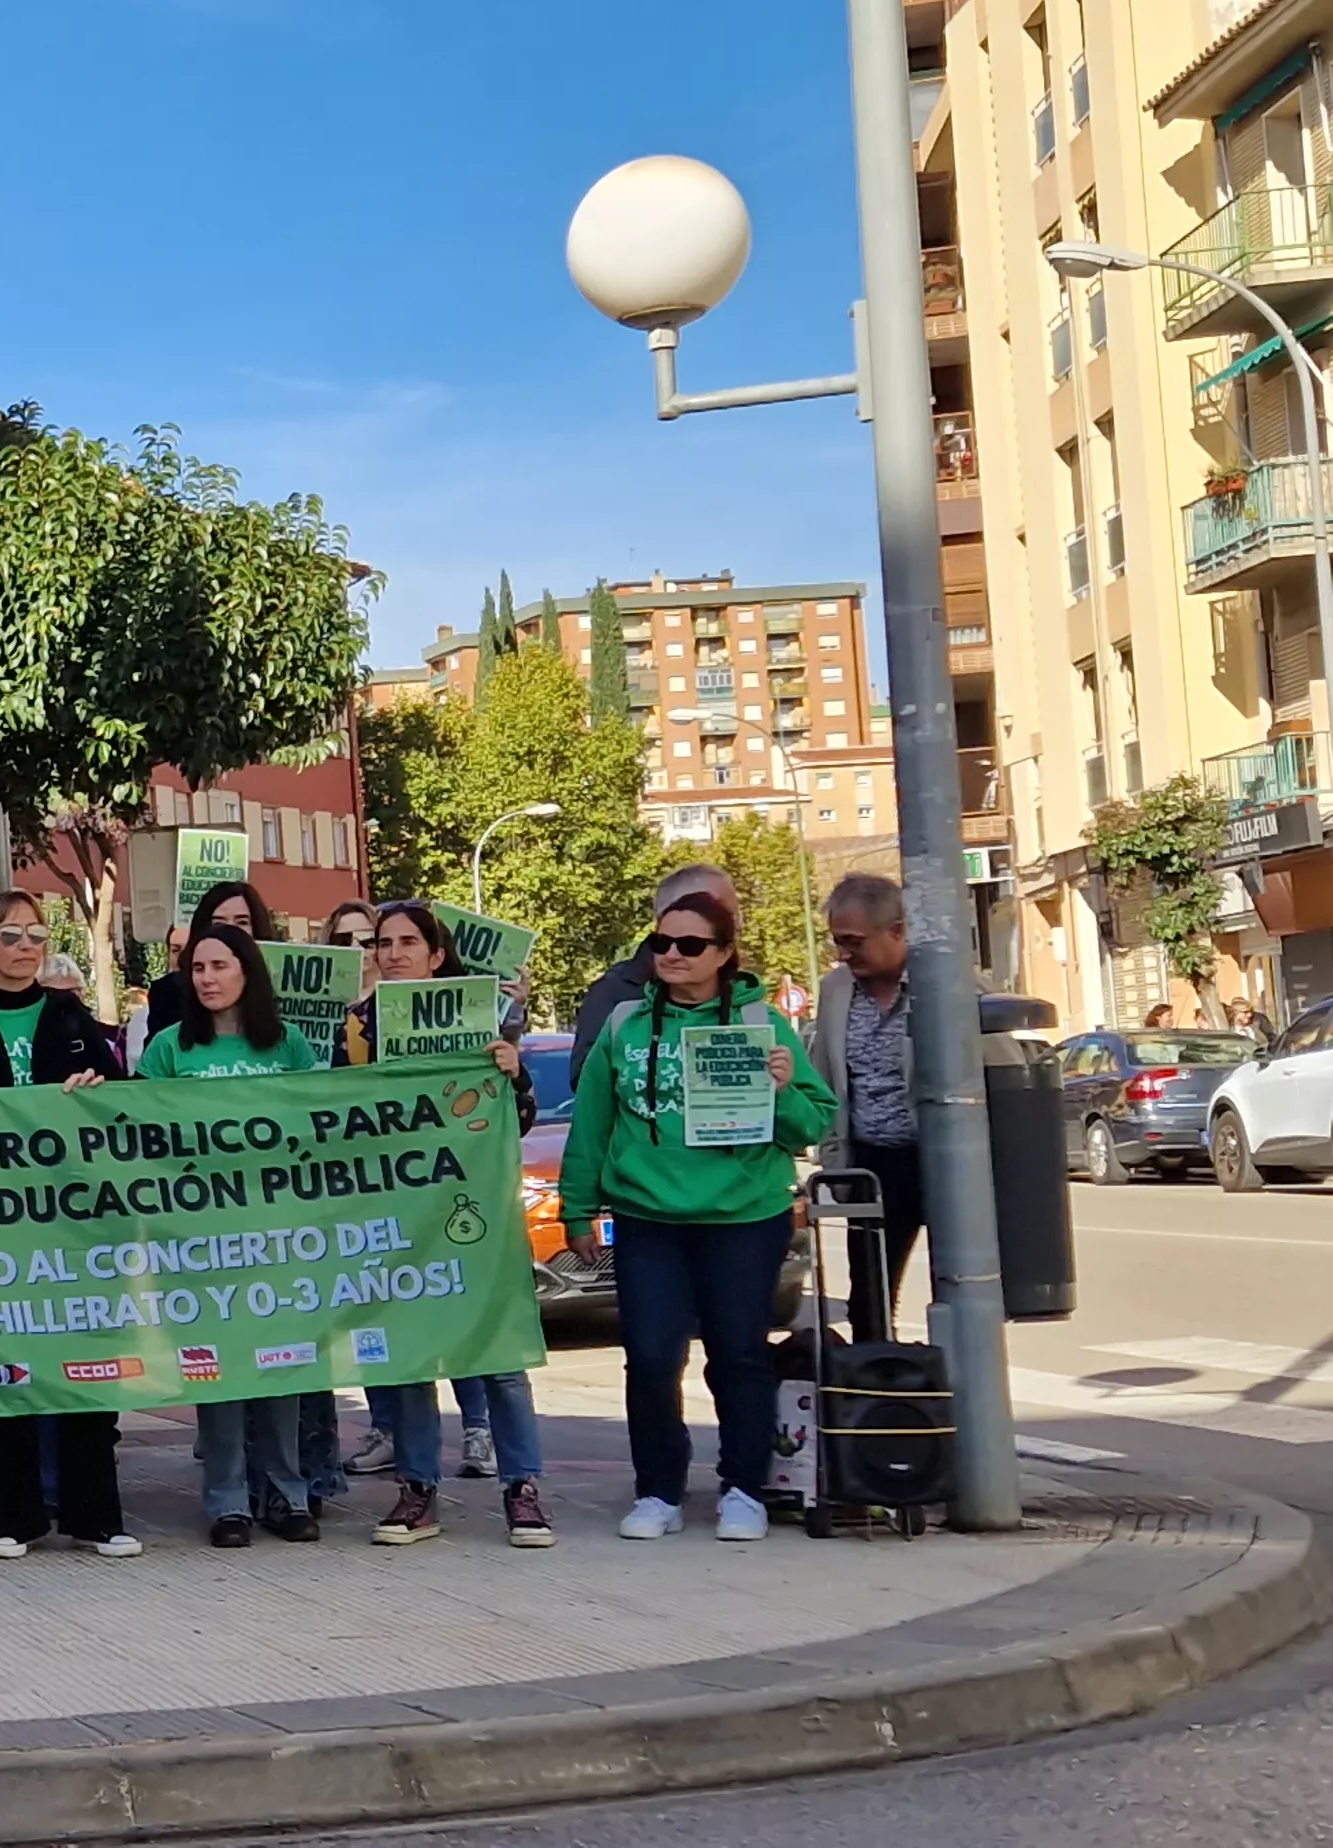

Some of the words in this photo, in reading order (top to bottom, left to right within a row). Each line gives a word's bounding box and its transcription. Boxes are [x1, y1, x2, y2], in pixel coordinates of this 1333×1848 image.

[200, 838, 231, 864] NO!
[453, 919, 503, 965] NO!
[281, 954, 333, 995] NO!
[412, 989, 464, 1030] NO!
[385, 1038, 403, 1057] AL
[407, 1031, 493, 1057] CONCIERTO
[80, 1111, 302, 1163] PÚBLICO,
[310, 1092, 444, 1144] PARA
[261, 1145, 467, 1208] PÚBLICA
[27, 1247, 77, 1285] AL
[85, 1226, 327, 1281] CONCIERTO
[337, 1217, 412, 1254] DEL
[201, 1286, 237, 1323] Y
[247, 1277, 321, 1316] 0-3
[330, 1258, 466, 1309] AÑOS!
